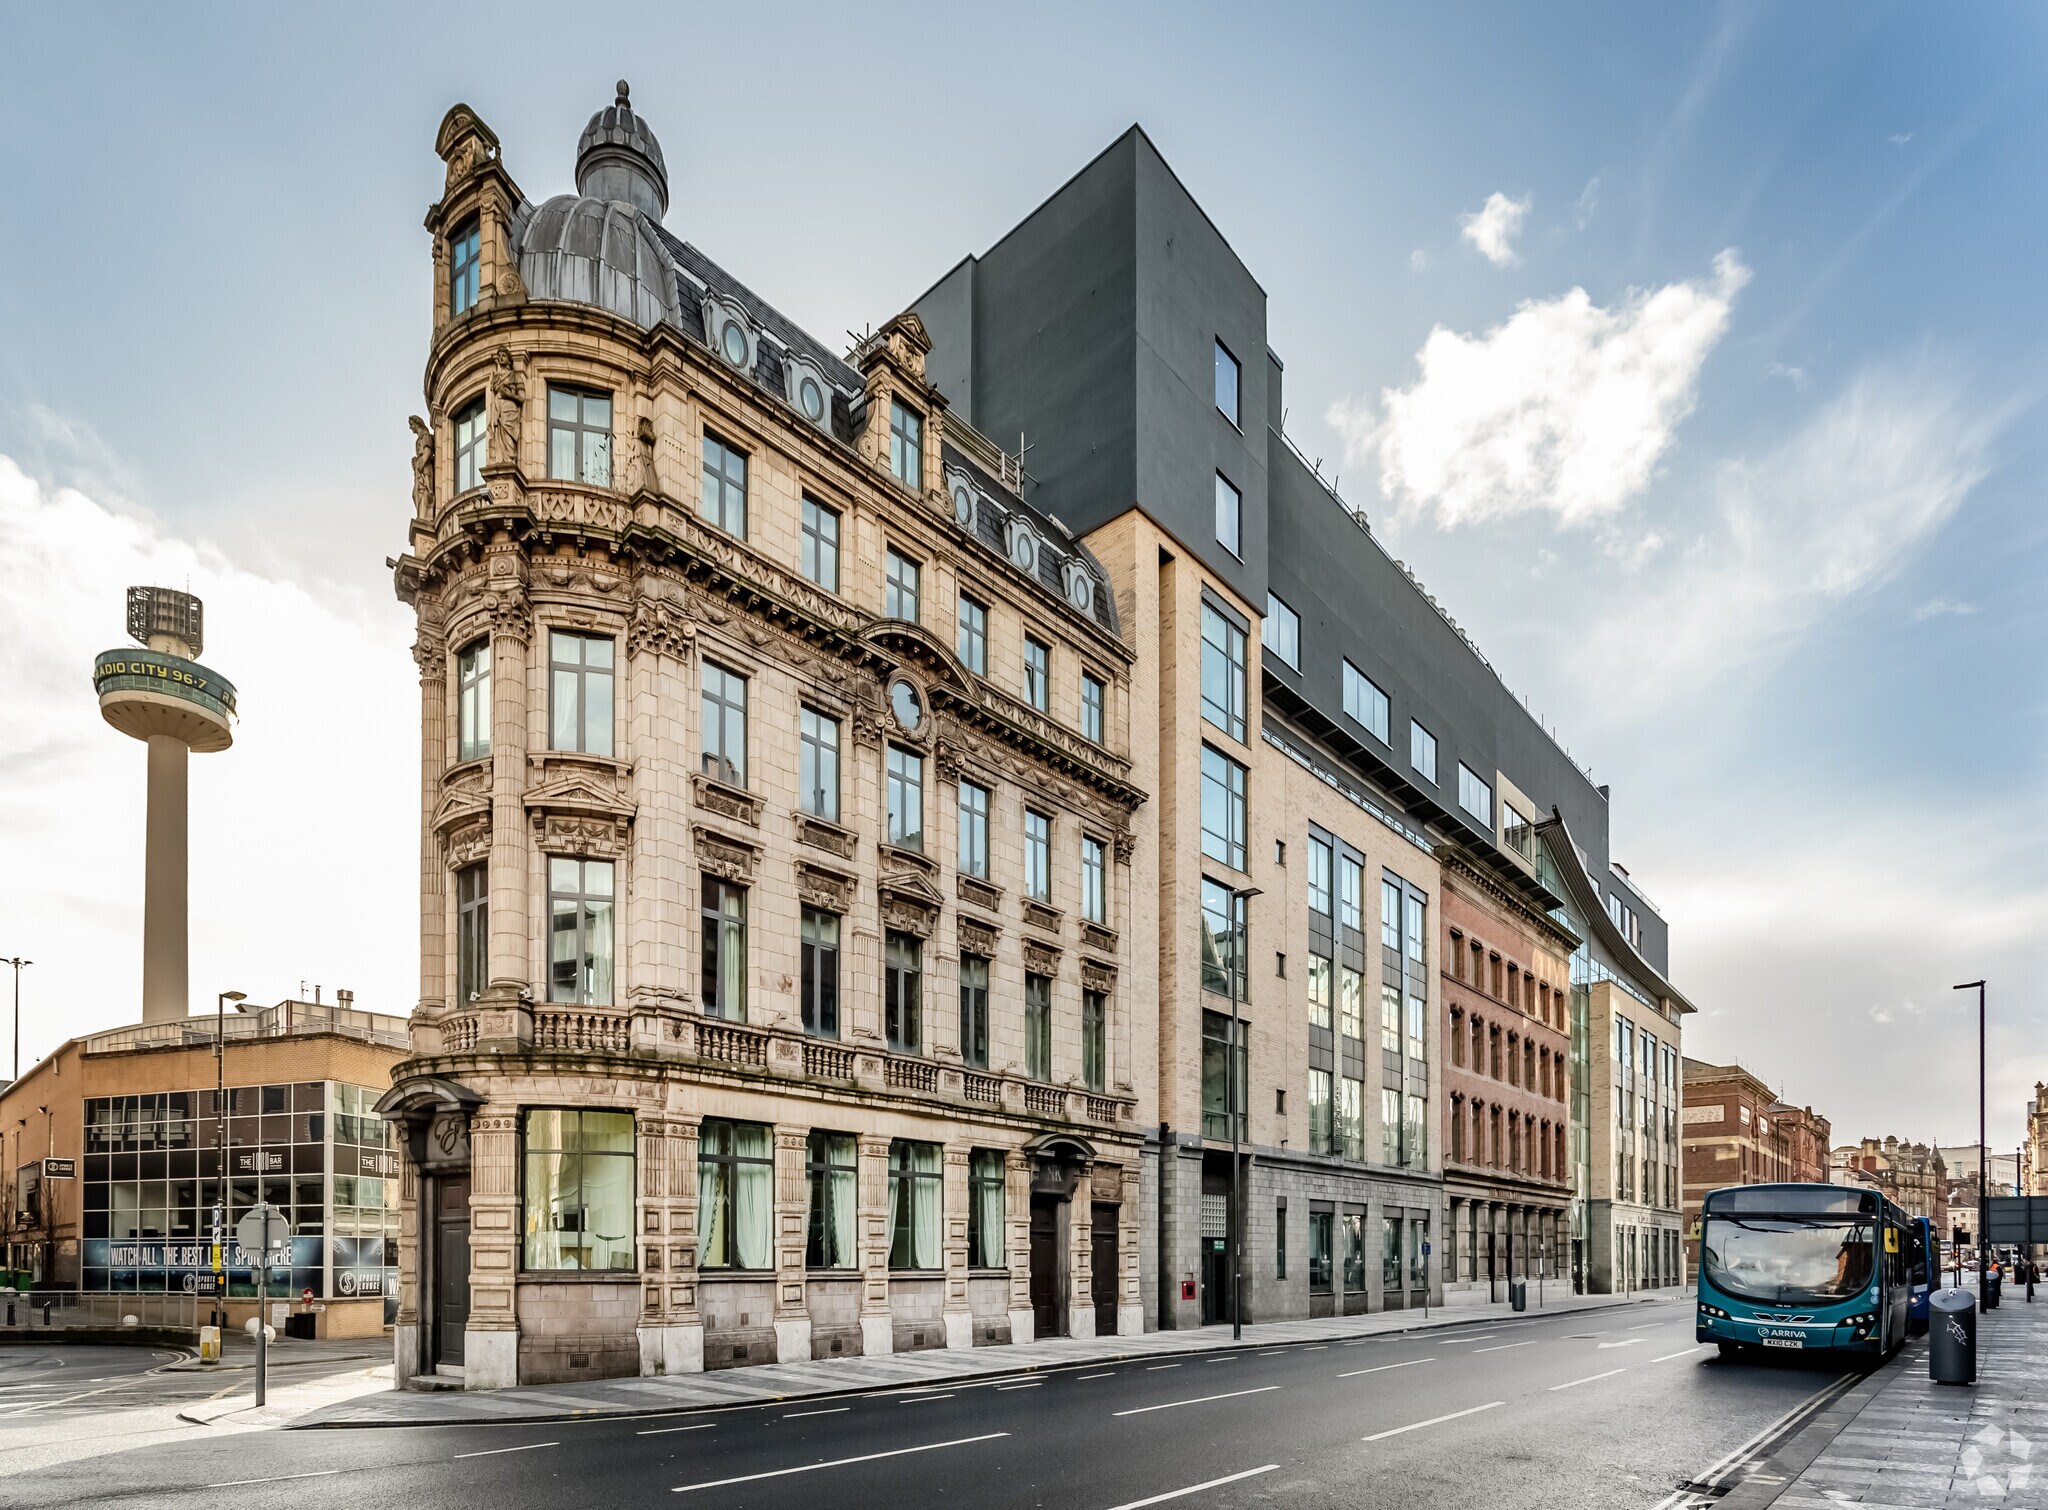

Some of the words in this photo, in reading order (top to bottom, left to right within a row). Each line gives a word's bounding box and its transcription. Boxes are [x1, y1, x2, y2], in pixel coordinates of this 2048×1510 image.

[95, 662, 126, 680] RADIO
[130, 663, 167, 677] CITY
[240, 1158, 252, 1166] THE
[252, 1151, 270, 1171] 1880
[269, 1157, 282, 1165] BAR
[361, 1158, 375, 1167] THE
[375, 1154, 393, 1174] 1880
[110, 1246, 139, 1266] WATCH
[141, 1246, 157, 1266] ALL
[162, 1246, 179, 1266] THE
[181, 1246, 204, 1266] BEST
[208, 1246, 228, 1266] LE
[1770, 1329, 1807, 1339] ARRIVA
